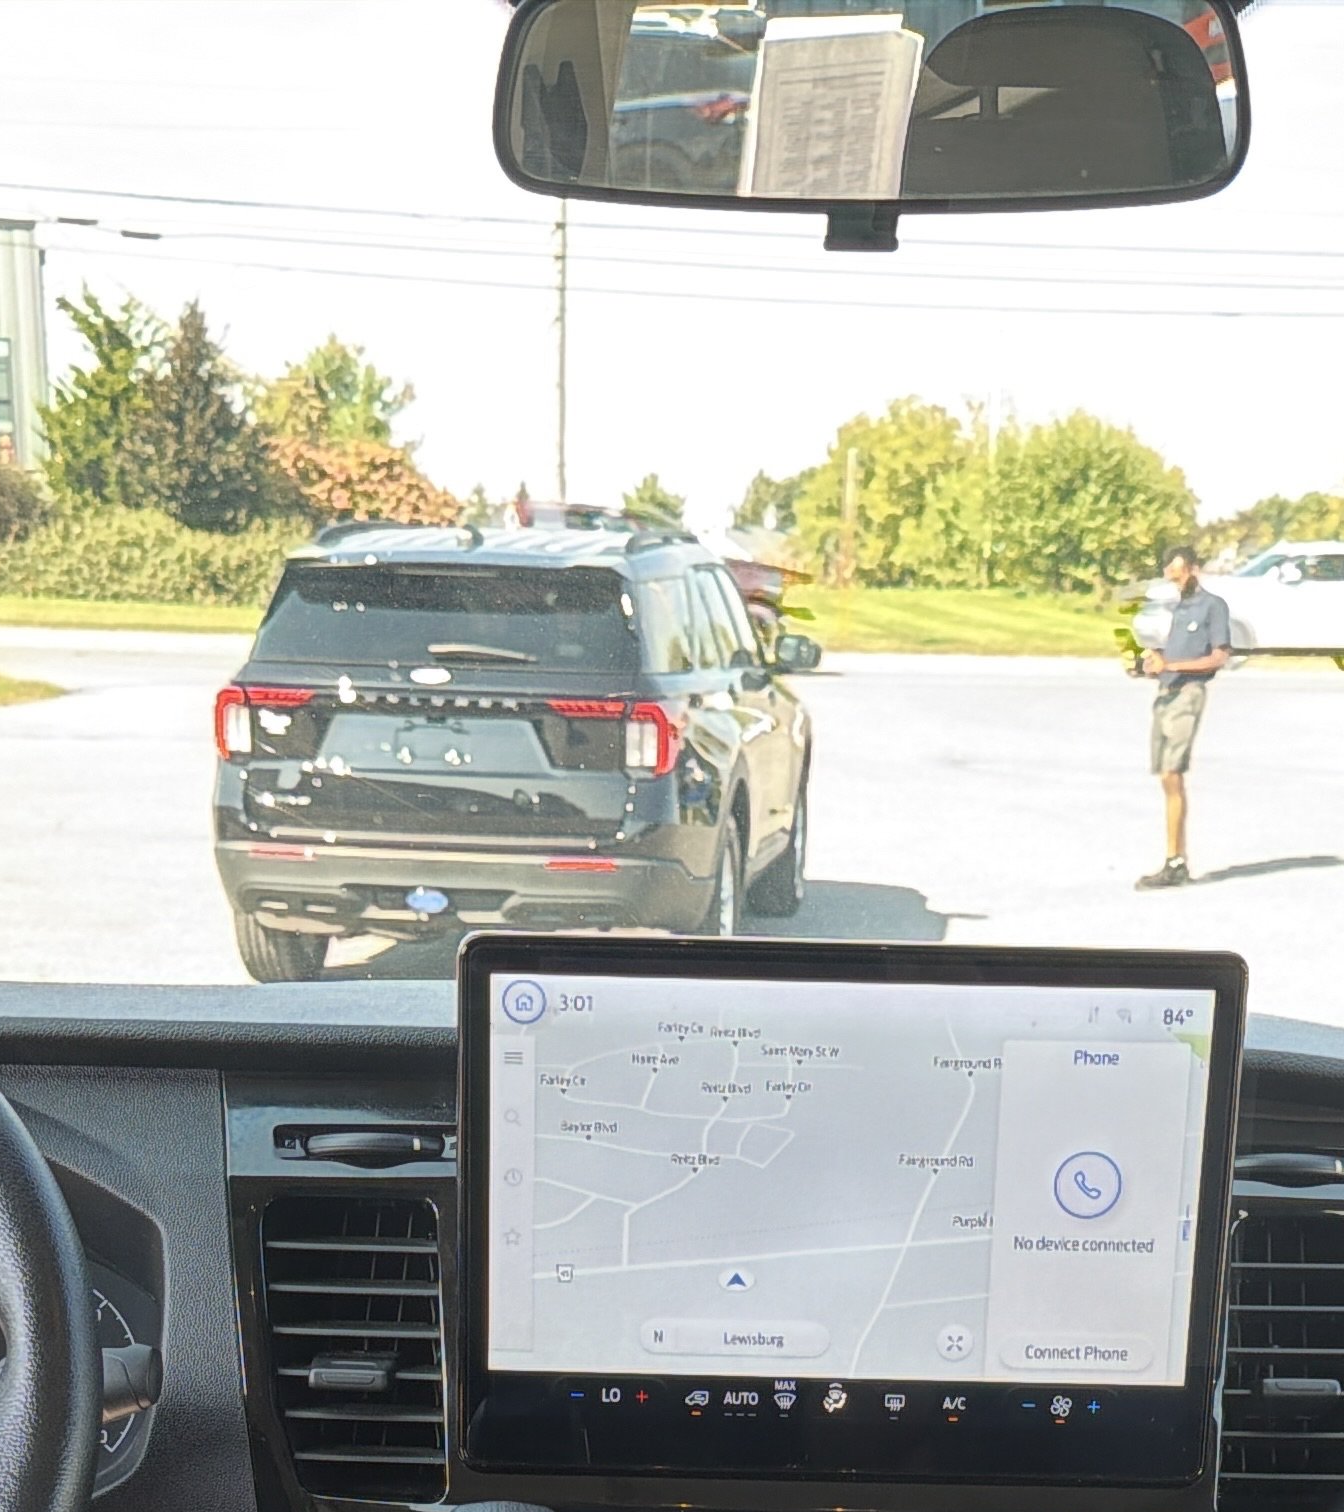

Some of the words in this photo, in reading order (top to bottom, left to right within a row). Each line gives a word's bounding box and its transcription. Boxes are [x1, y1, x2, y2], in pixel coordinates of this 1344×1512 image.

[559, 994, 593, 1012] 3:01
[1163, 1008, 1194, 1026] 84°
[1074, 1050, 1120, 1066] Phone
[898, 1153, 957, 1168] Fairground
[958, 1155, 974, 1168] Rd
[1014, 1236, 1034, 1251] No
[1036, 1236, 1080, 1252] device
[1082, 1238, 1155, 1254] connected
[653, 1330, 664, 1343] N
[723, 1331, 784, 1348] Lewisburg
[1025, 1344, 1081, 1361] Connect
[1084, 1346, 1129, 1363] Phone
[774, 1380, 797, 1391] MAX
[601, 1387, 622, 1403] LO
[723, 1391, 759, 1407] AUTO
[942, 1396, 967, 1411] A/C
